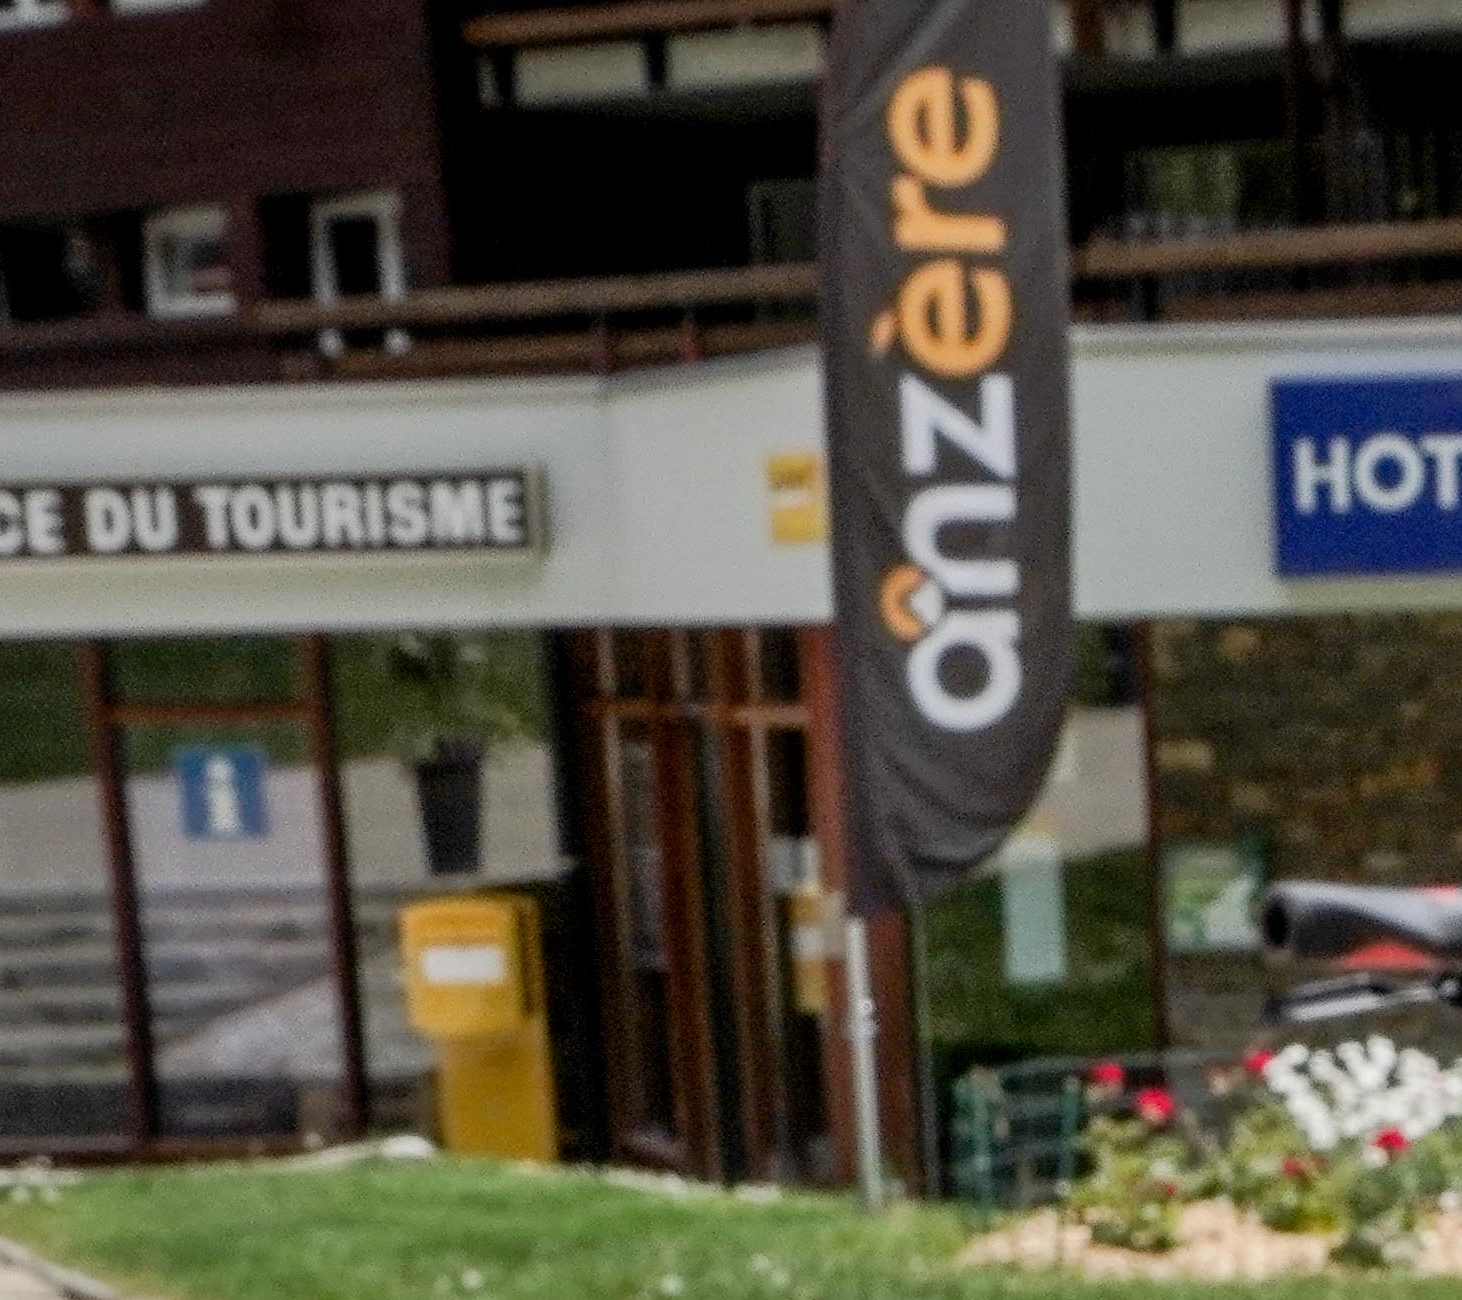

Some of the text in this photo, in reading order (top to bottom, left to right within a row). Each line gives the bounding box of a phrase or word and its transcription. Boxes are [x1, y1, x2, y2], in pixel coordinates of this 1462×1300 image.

[84, 488, 179, 553] DU
[196, 480, 524, 551] TOURISME
[870, 64, 1022, 732] anzère
